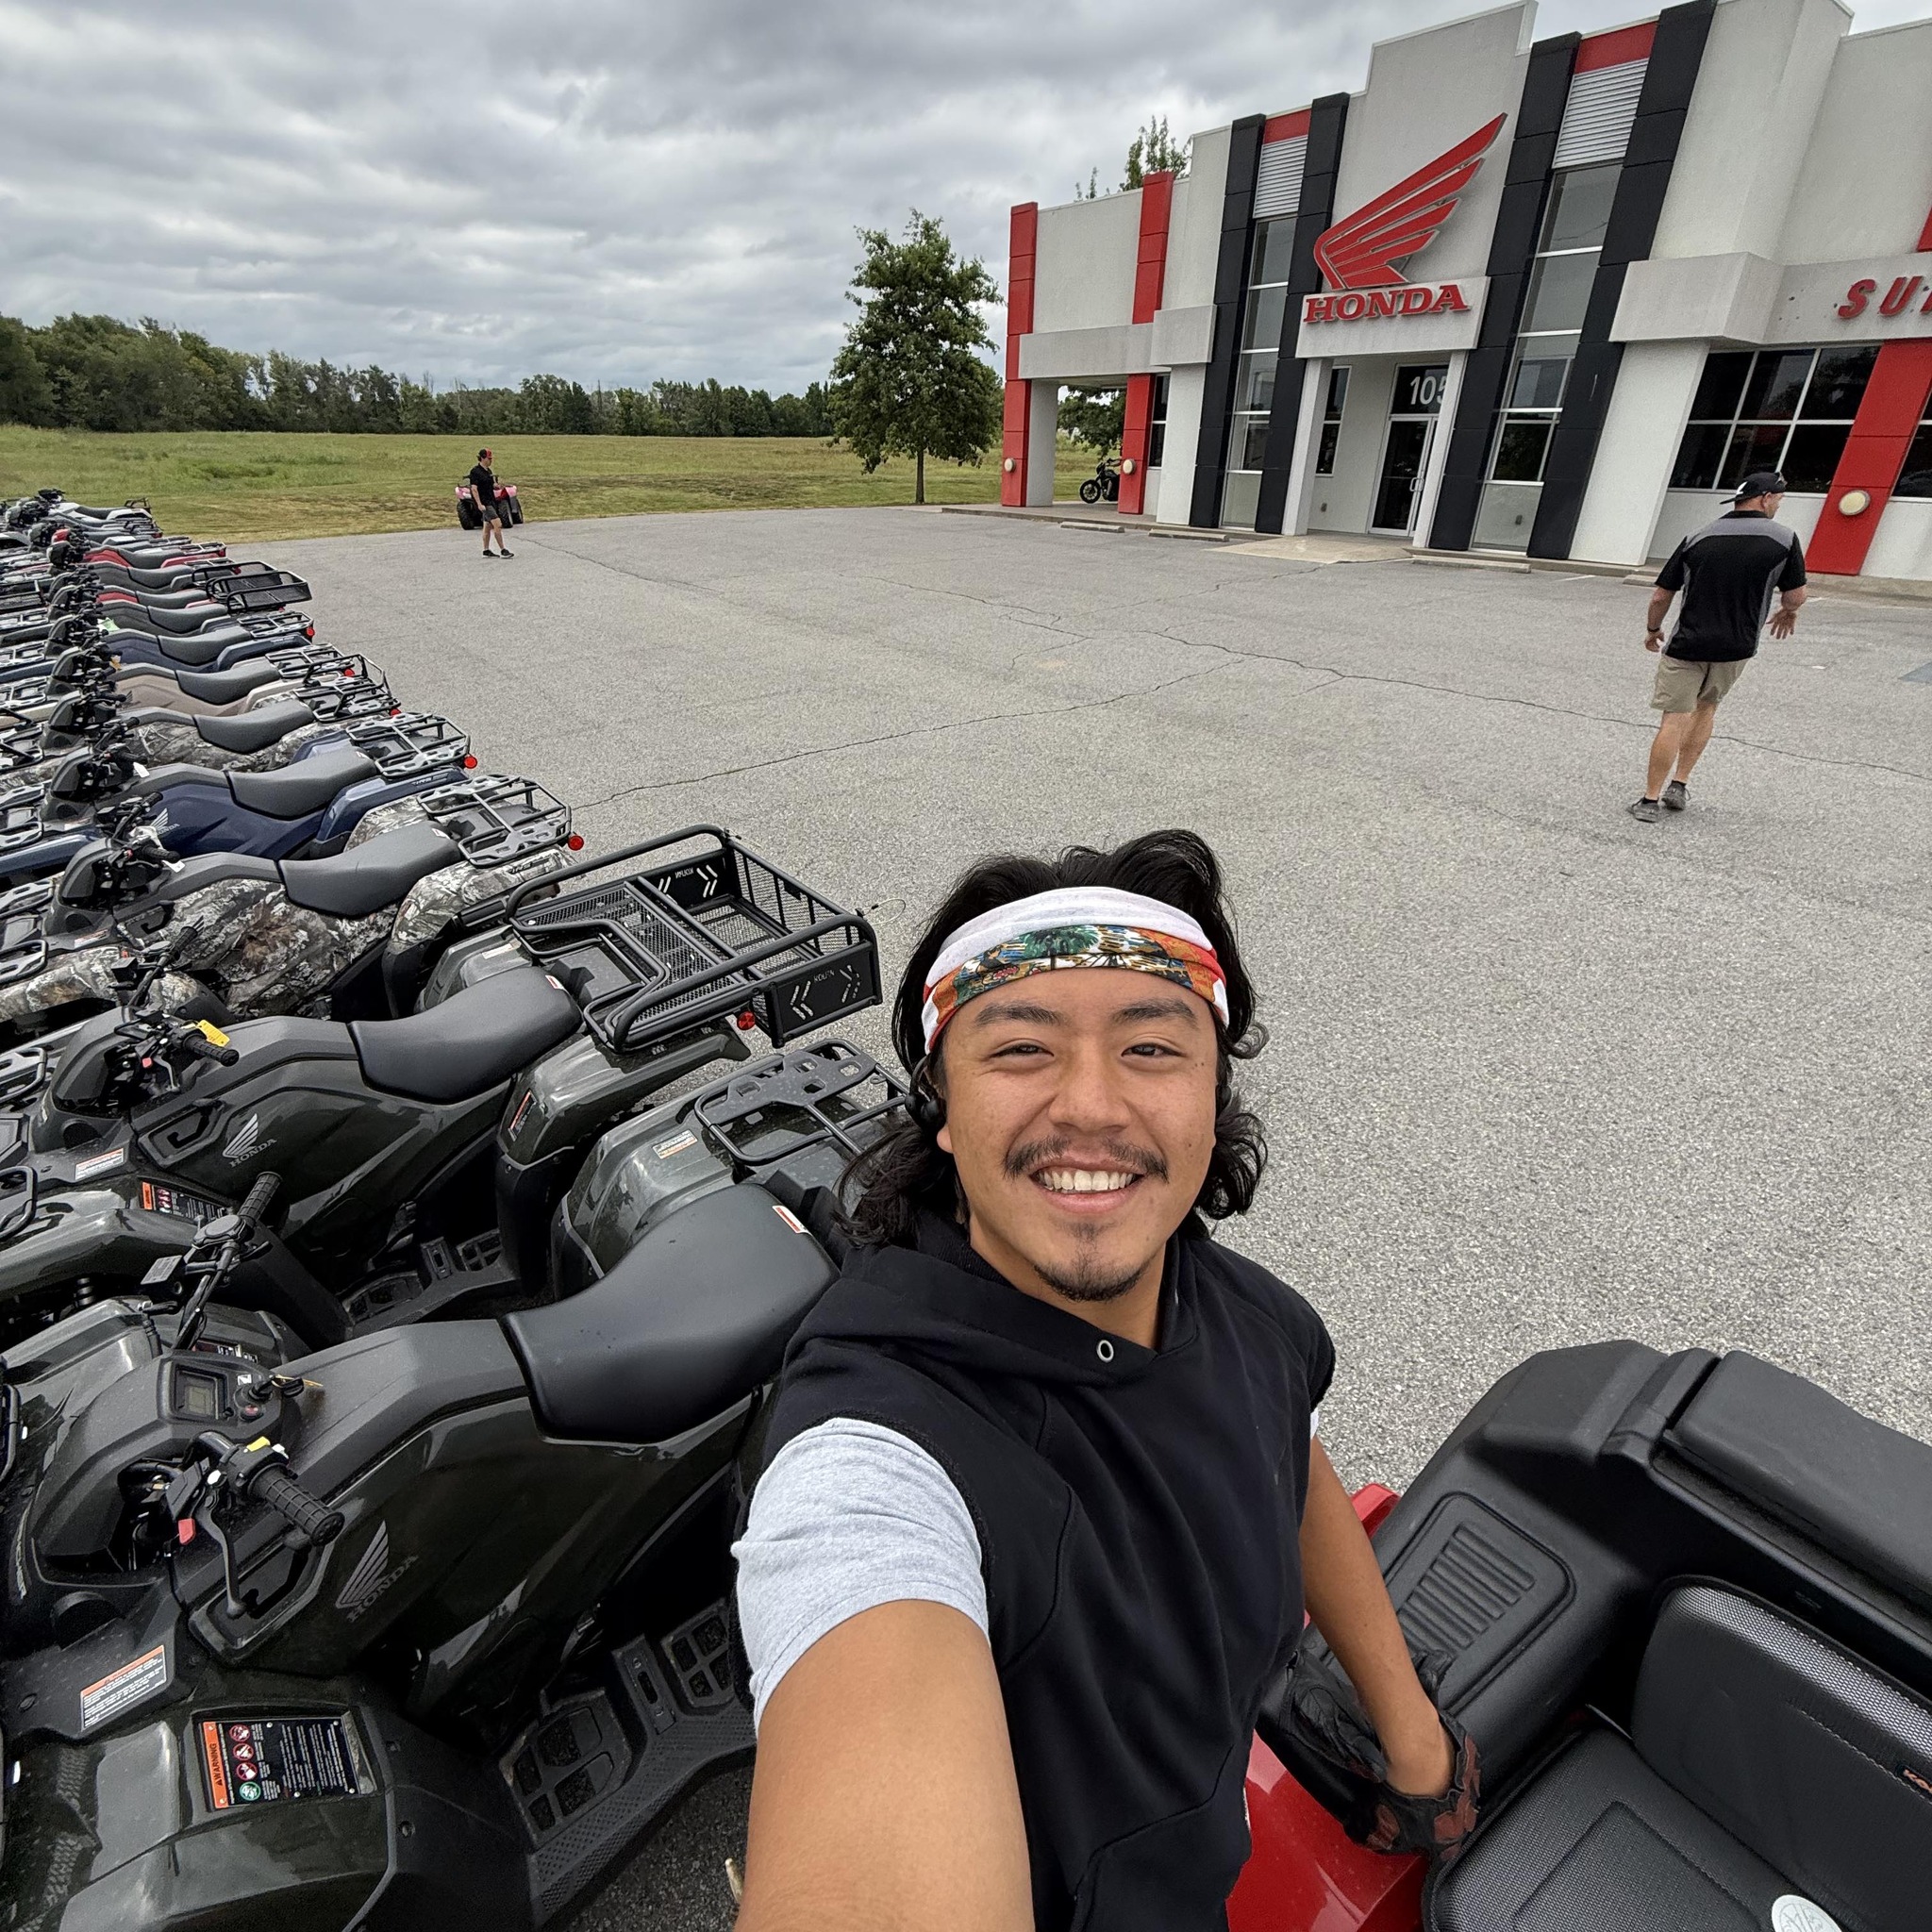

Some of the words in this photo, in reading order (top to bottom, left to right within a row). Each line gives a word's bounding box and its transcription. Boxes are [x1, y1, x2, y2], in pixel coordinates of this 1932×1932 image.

[1303, 284, 1470, 323] HONDA
[1838, 276, 1932, 319] SU
[229, 1139, 277, 1168] HONDA
[346, 1556, 419, 1623] HONDA
[209, 1742, 222, 1780] WARNING
